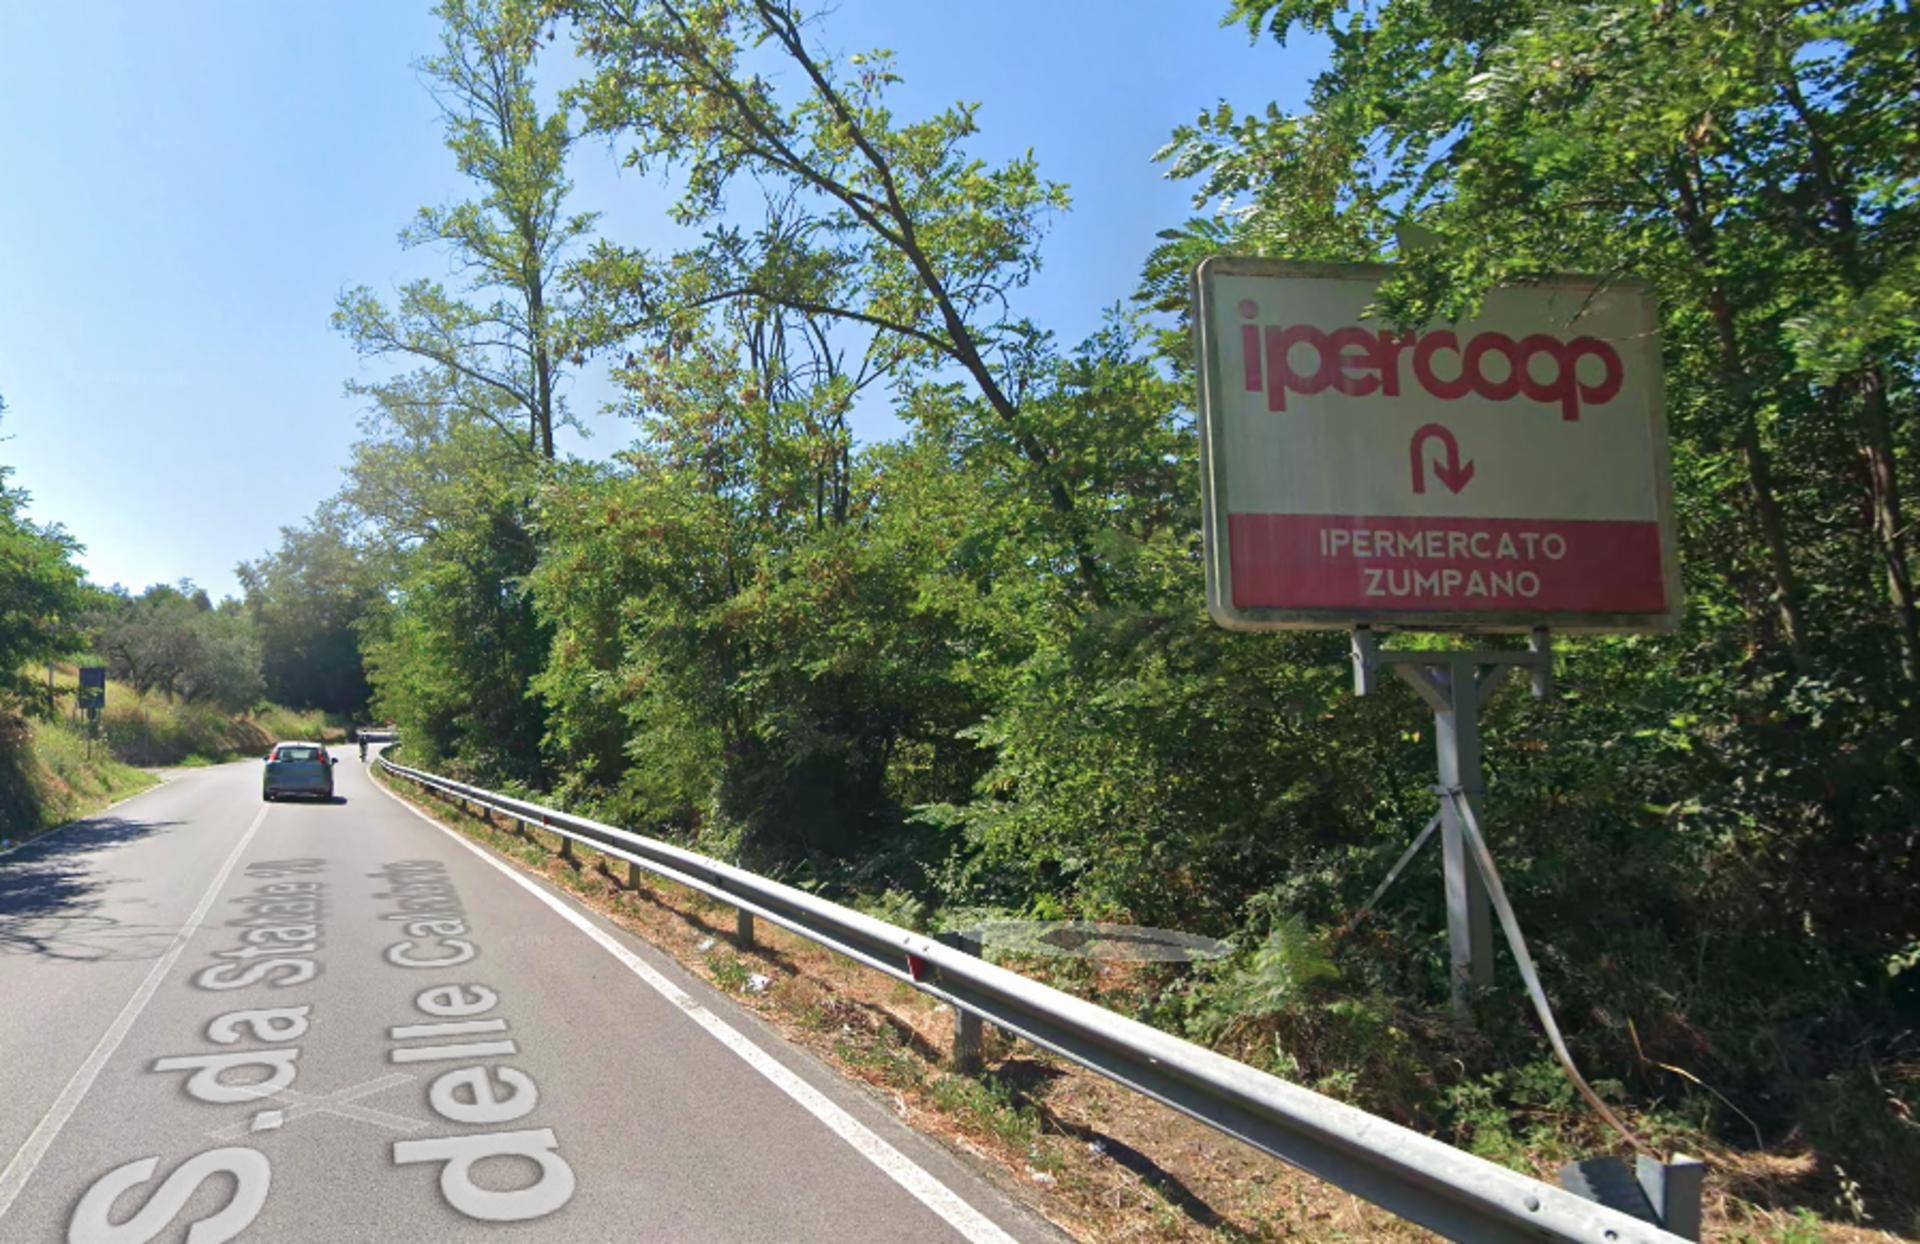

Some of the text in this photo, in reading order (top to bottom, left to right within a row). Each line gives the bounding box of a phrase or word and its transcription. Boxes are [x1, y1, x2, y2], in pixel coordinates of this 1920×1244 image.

[1238, 299, 1624, 422] ipercoop
[1319, 528, 1567, 560] IPERMERCATO
[1364, 568, 1541, 599] ZUMPANO
